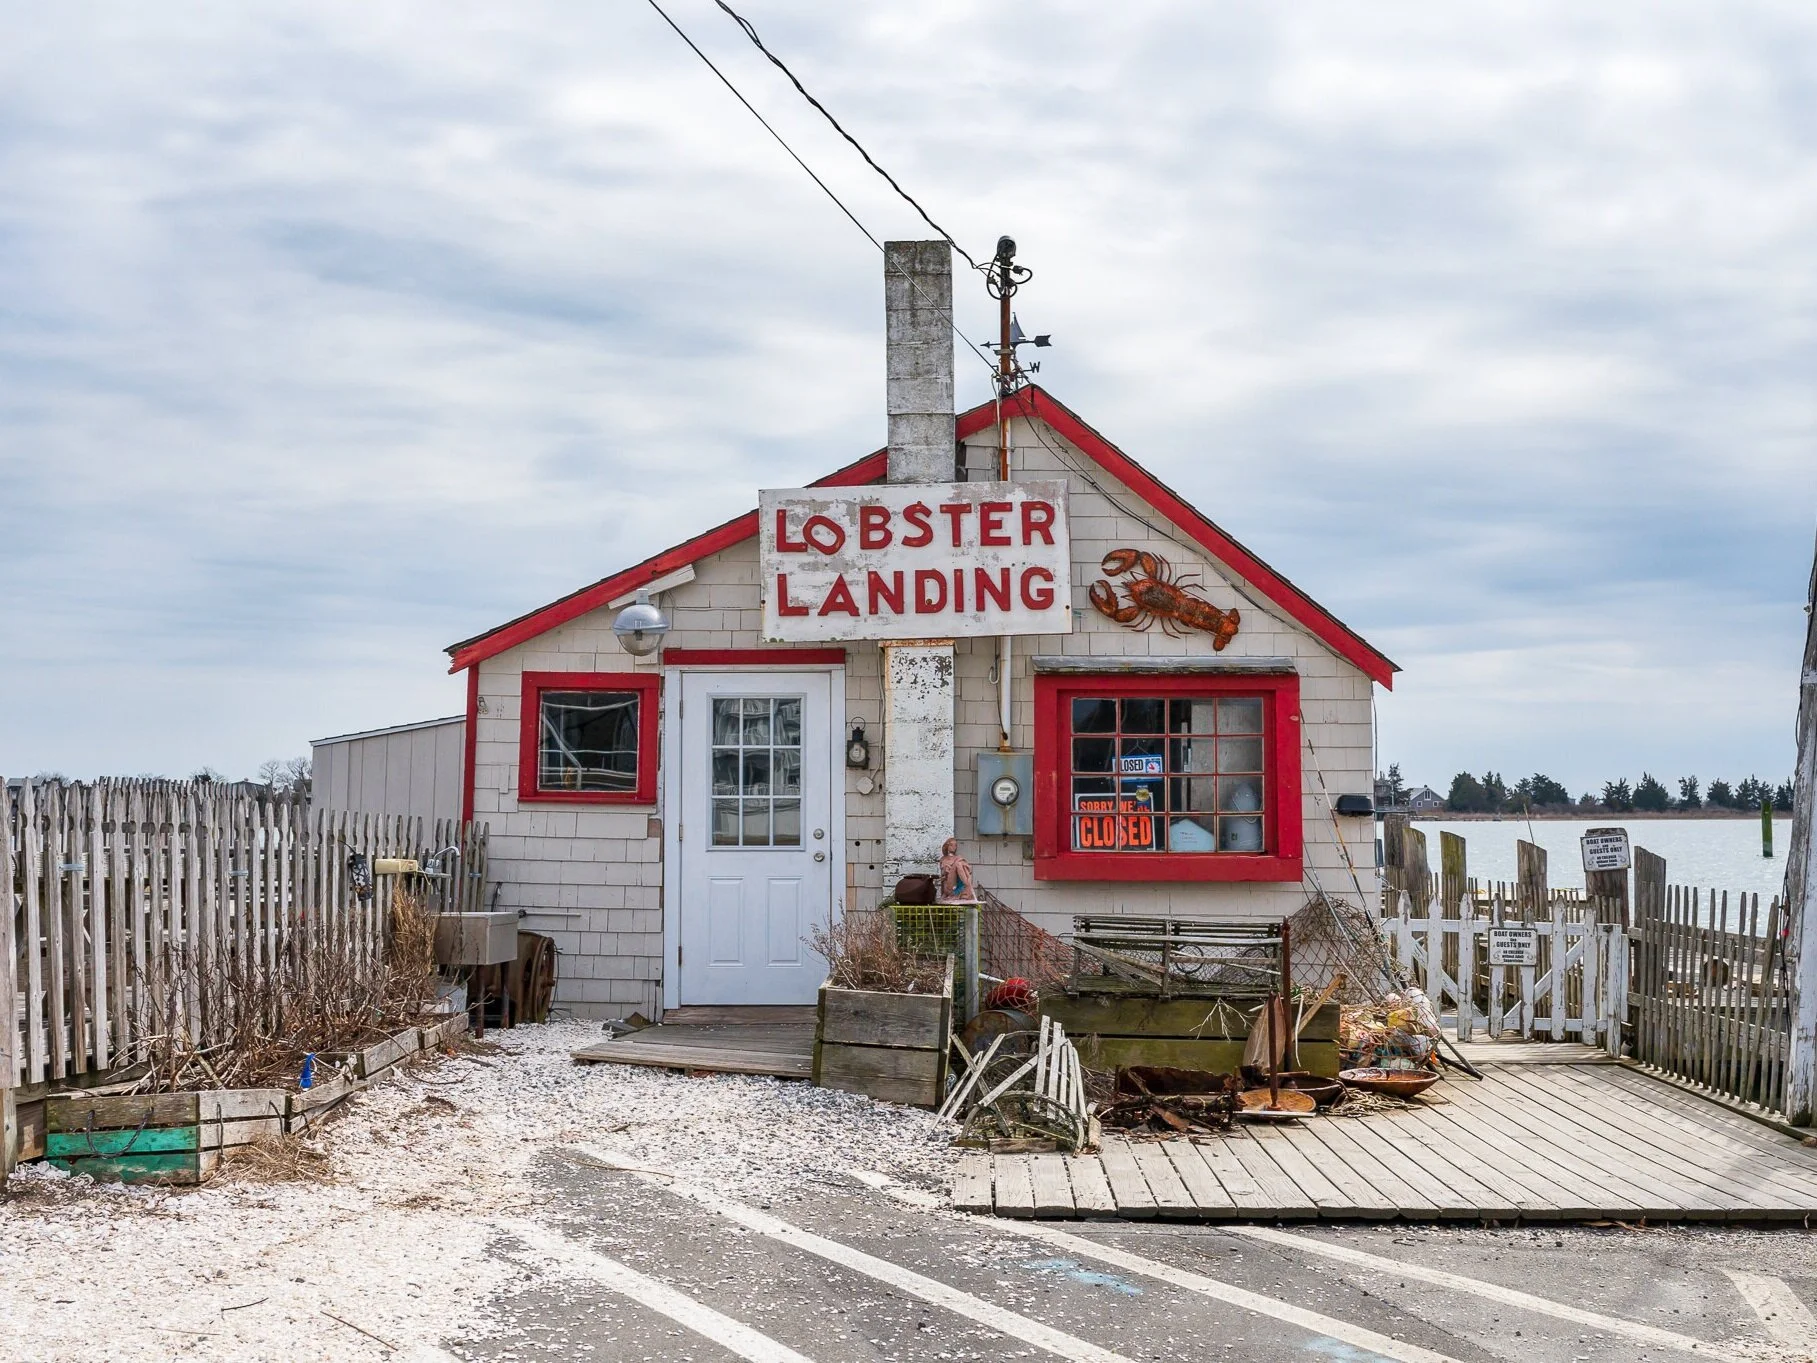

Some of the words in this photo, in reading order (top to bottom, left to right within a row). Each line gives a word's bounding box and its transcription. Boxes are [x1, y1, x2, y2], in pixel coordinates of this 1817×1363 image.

[1029, 361, 1041, 373] W
[776, 500, 1055, 555] LOBSTER
[777, 566, 1055, 617] LANDING
[1118, 759, 1144, 772] LOSED
[1080, 801, 1114, 811] SORRY
[1080, 816, 1152, 847] CLOSED
